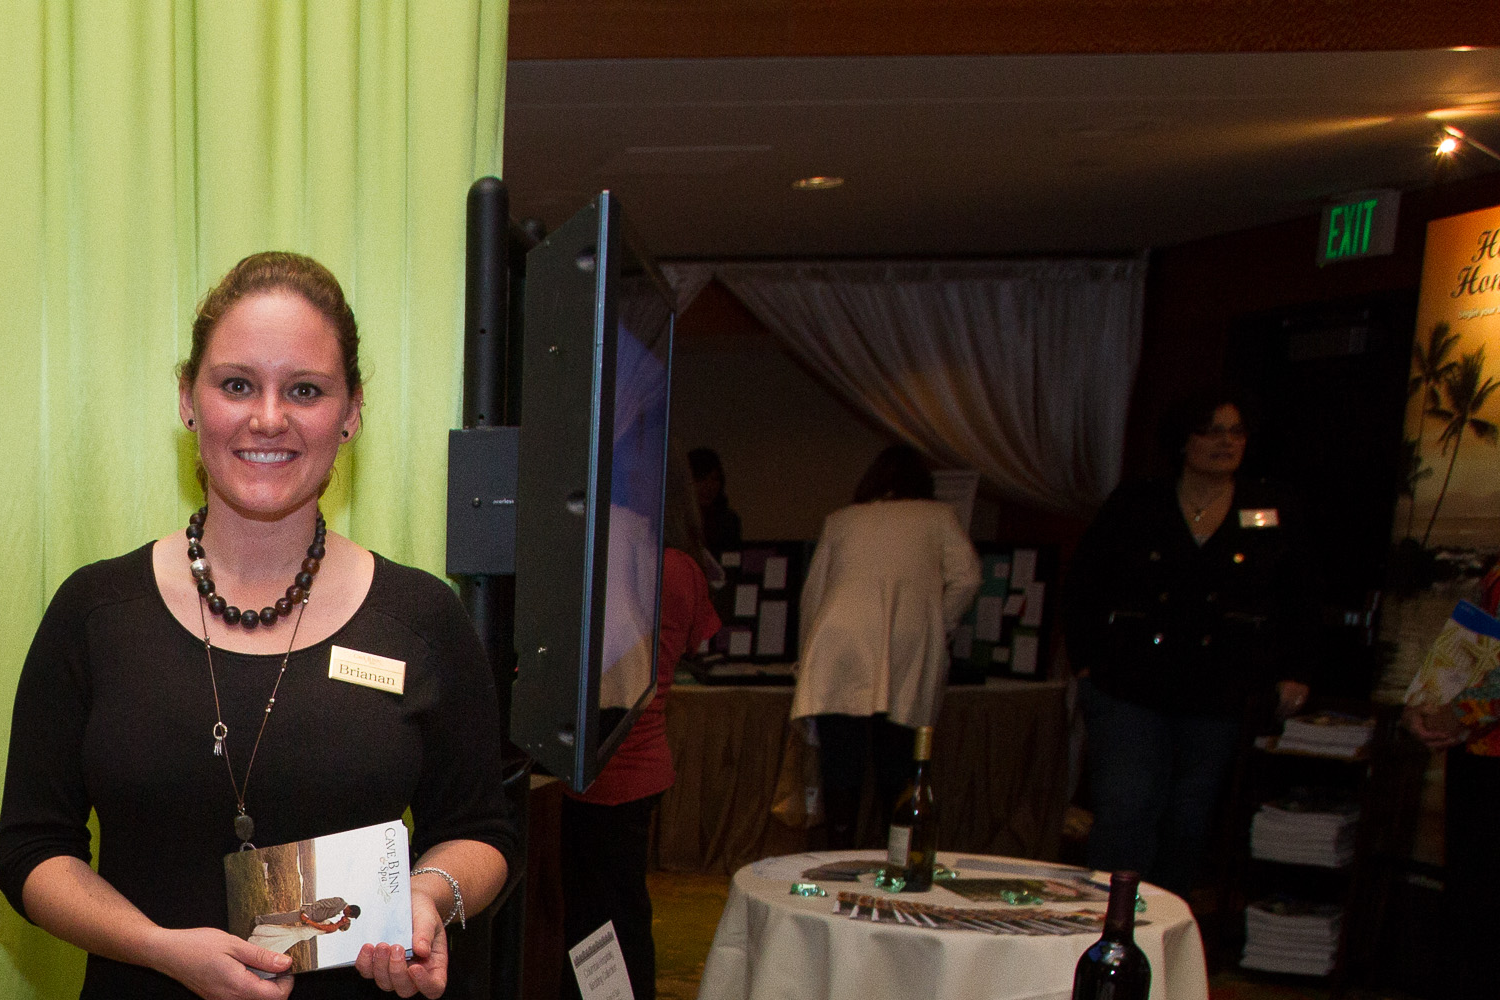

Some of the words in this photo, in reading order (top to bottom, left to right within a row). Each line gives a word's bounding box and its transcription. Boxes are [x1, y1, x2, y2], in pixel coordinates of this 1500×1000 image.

[1325, 199, 1378, 259] EXIT
[1471, 228, 1500, 263] H
[339, 663, 395, 686] Brianan
[385, 827, 396, 859] CAVE
[378, 866, 389, 882] Spa
[388, 860, 400, 870] B
[389, 871, 400, 894] INN
